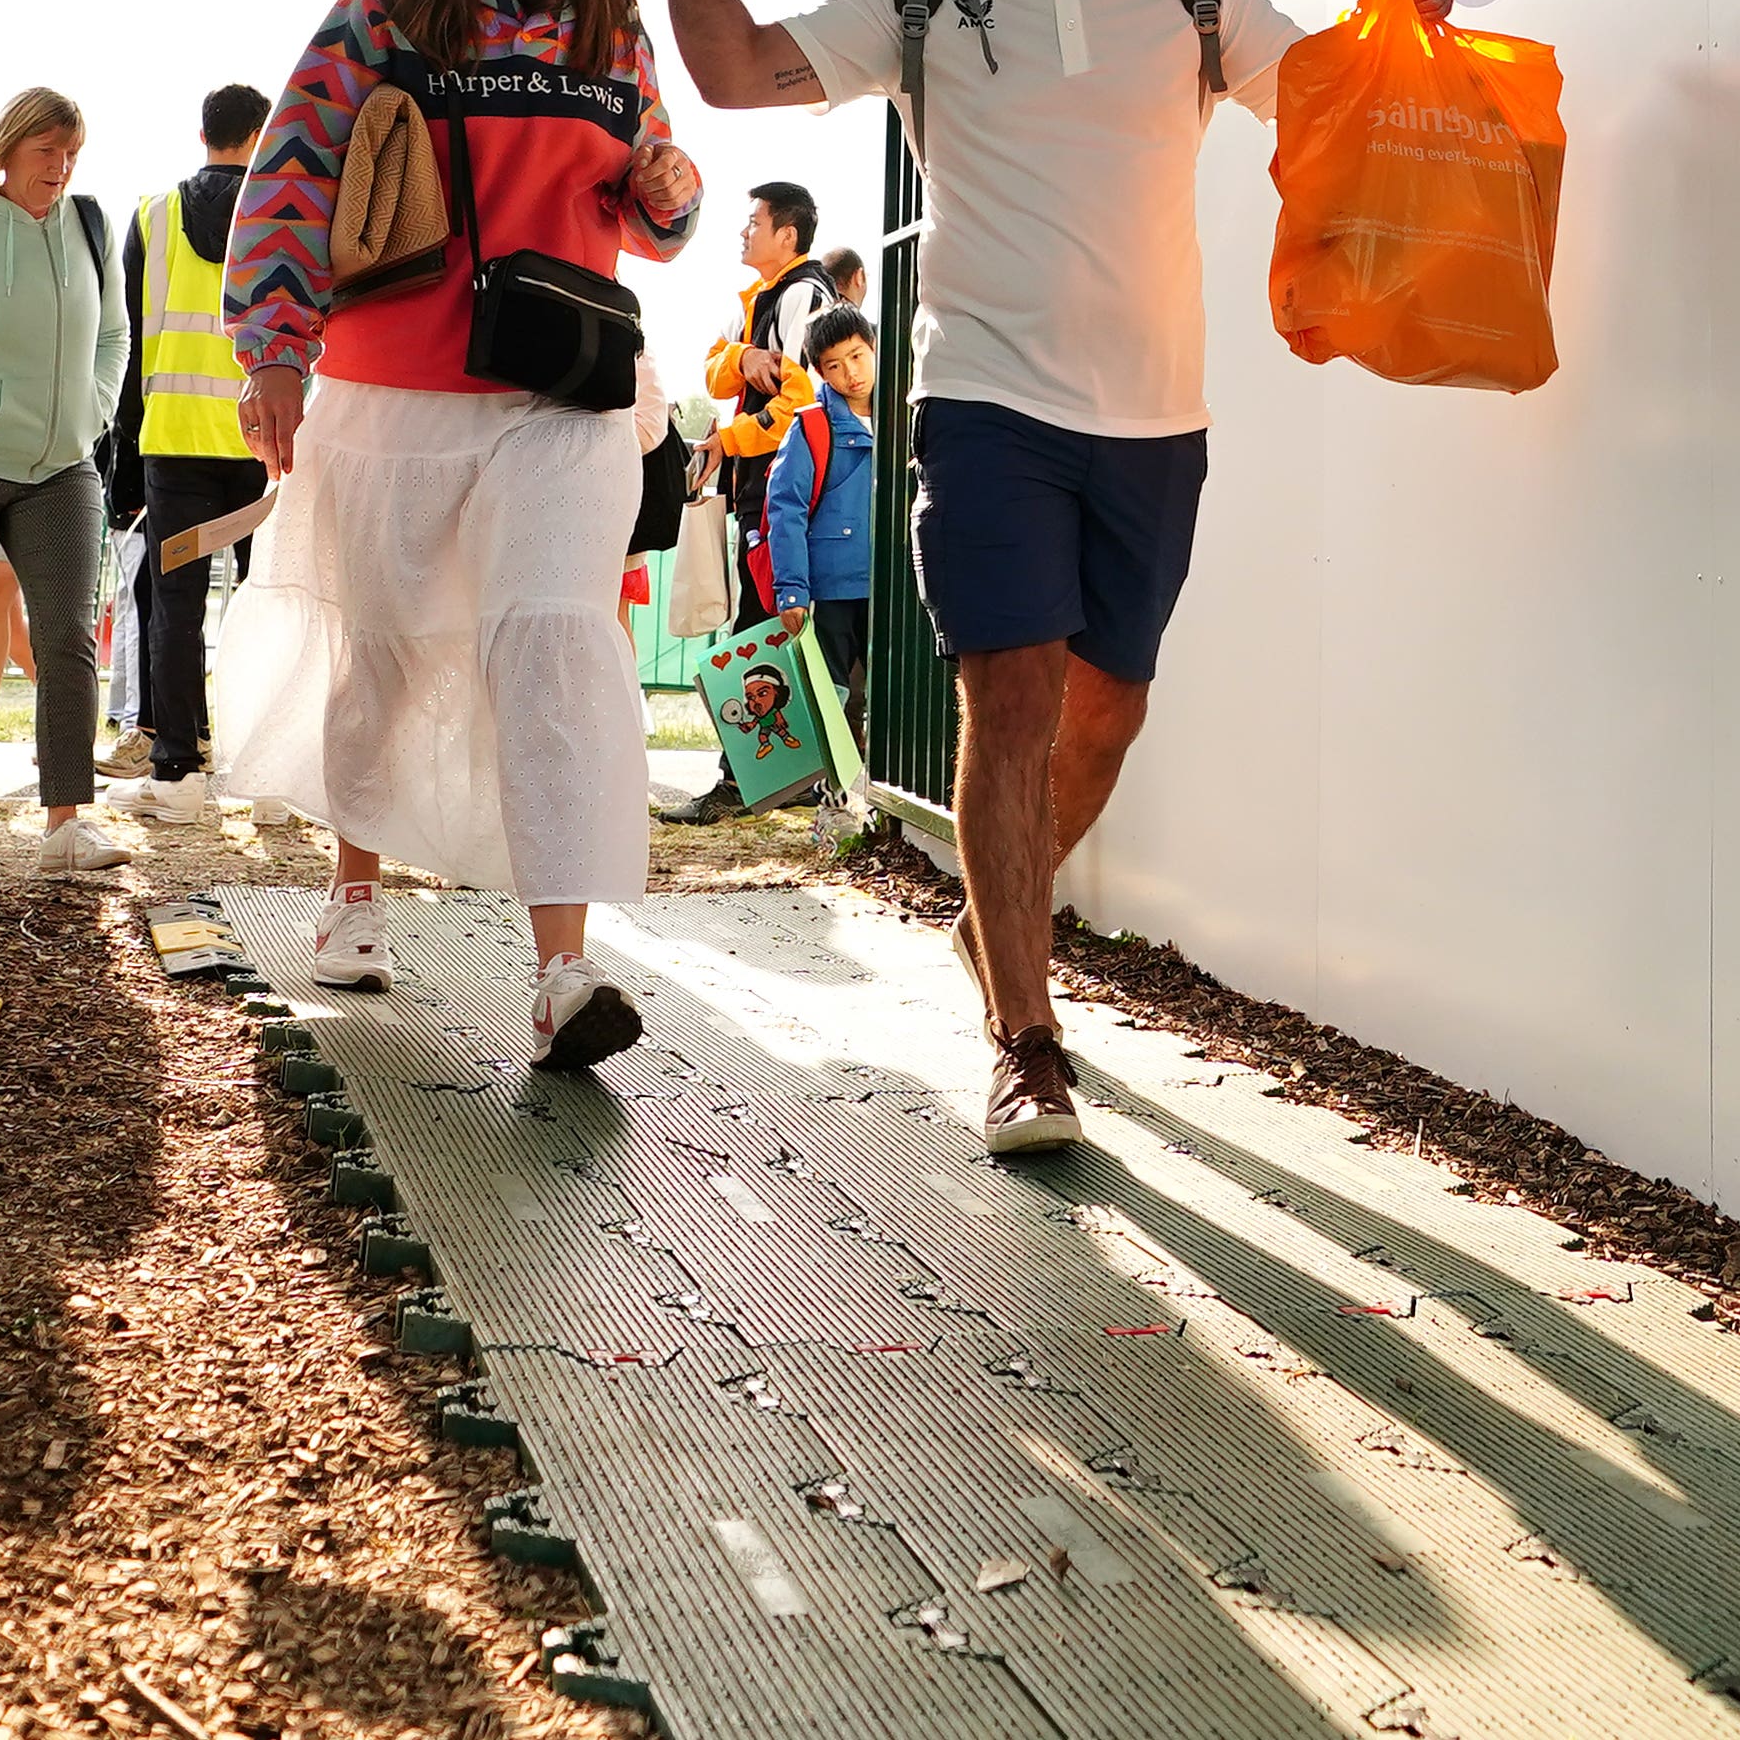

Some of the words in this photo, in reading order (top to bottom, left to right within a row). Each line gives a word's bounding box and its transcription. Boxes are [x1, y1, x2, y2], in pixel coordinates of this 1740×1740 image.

[957, 16, 995, 29] AMC
[527, 71, 552, 94] &
[559, 75, 625, 114] Lewis
